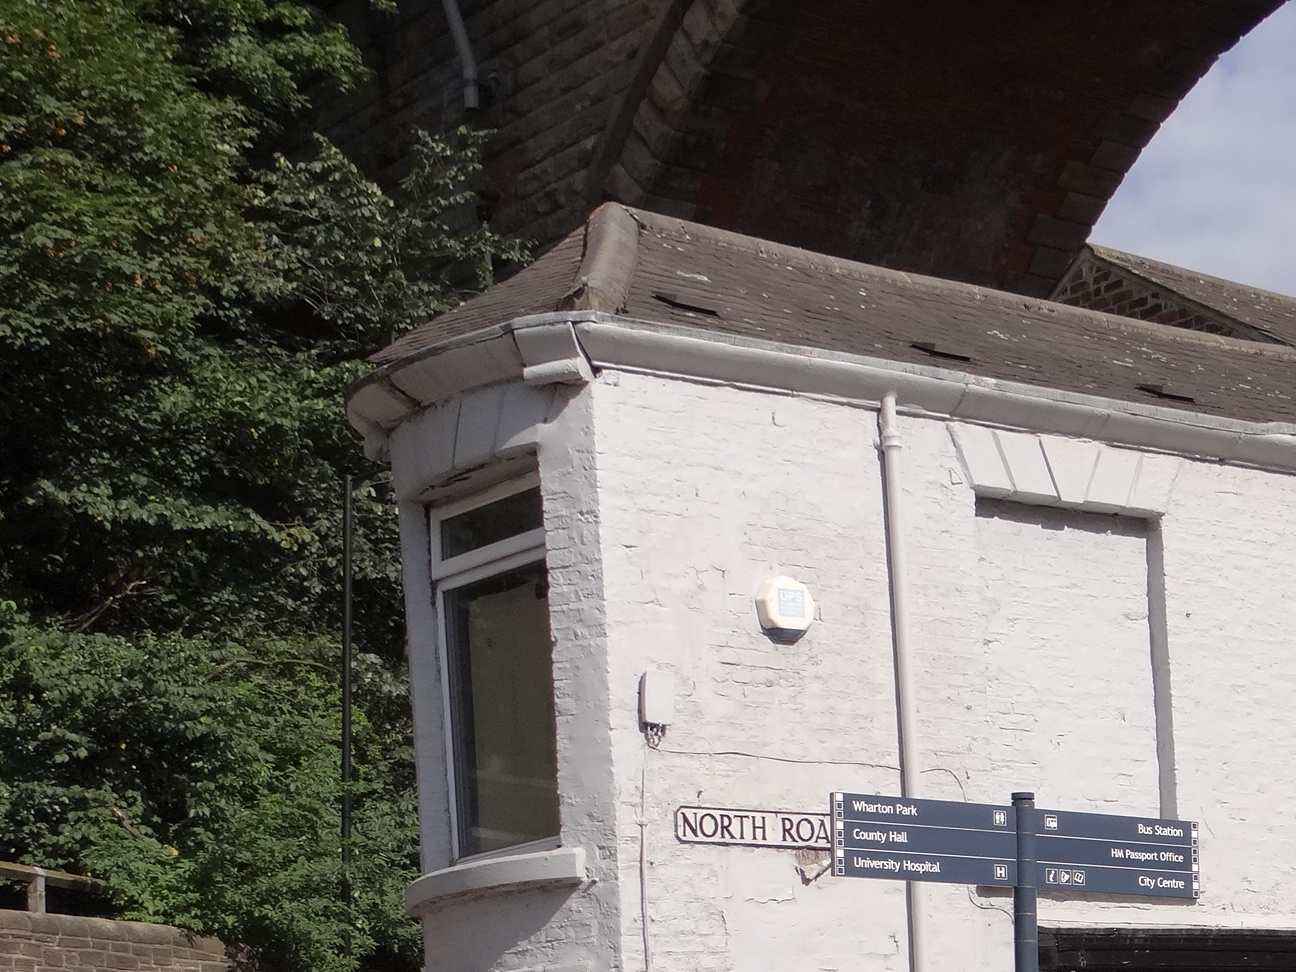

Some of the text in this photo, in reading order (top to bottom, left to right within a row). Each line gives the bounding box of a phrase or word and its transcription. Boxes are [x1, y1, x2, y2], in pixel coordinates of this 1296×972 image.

[780, 590, 803, 602] UPS
[852, 800, 918, 817] Wharton Park
[680, 811, 832, 844] NORTH ROA
[1138, 823, 1184, 837] Bus Station
[853, 828, 909, 844] County Hall
[1111, 848, 1184, 863] HM Passport Office
[853, 856, 941, 874] University Hospital
[1138, 875, 1185, 889] City Centre
